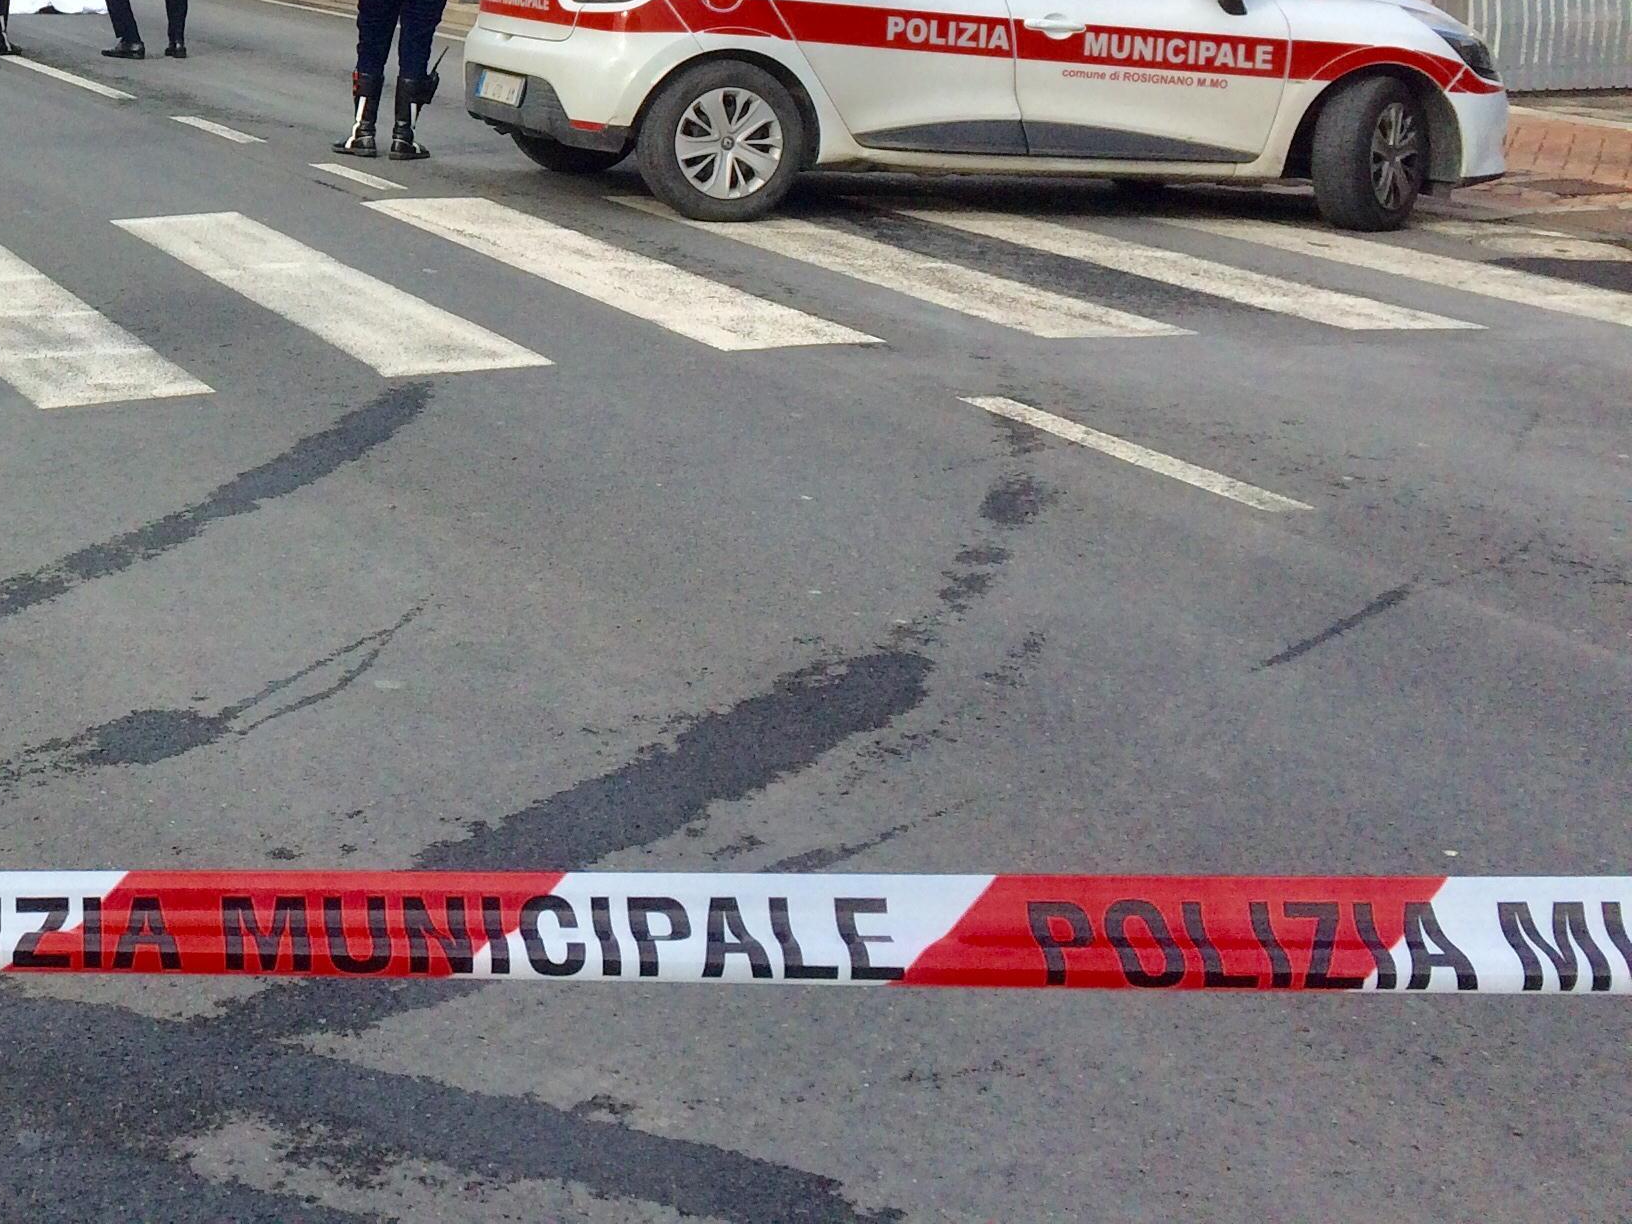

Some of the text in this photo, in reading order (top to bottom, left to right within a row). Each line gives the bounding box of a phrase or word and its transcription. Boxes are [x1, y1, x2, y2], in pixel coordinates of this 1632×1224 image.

[885, 16, 1274, 70] POLIZIA MUNICIPALE
[1062, 69, 1107, 80] comune
[1109, 71, 1120, 81] di
[1123, 72, 1194, 87] ROSIGNANO
[220, 895, 905, 980] MUNICIPALE
[1026, 899, 1479, 991] POLIZIA
